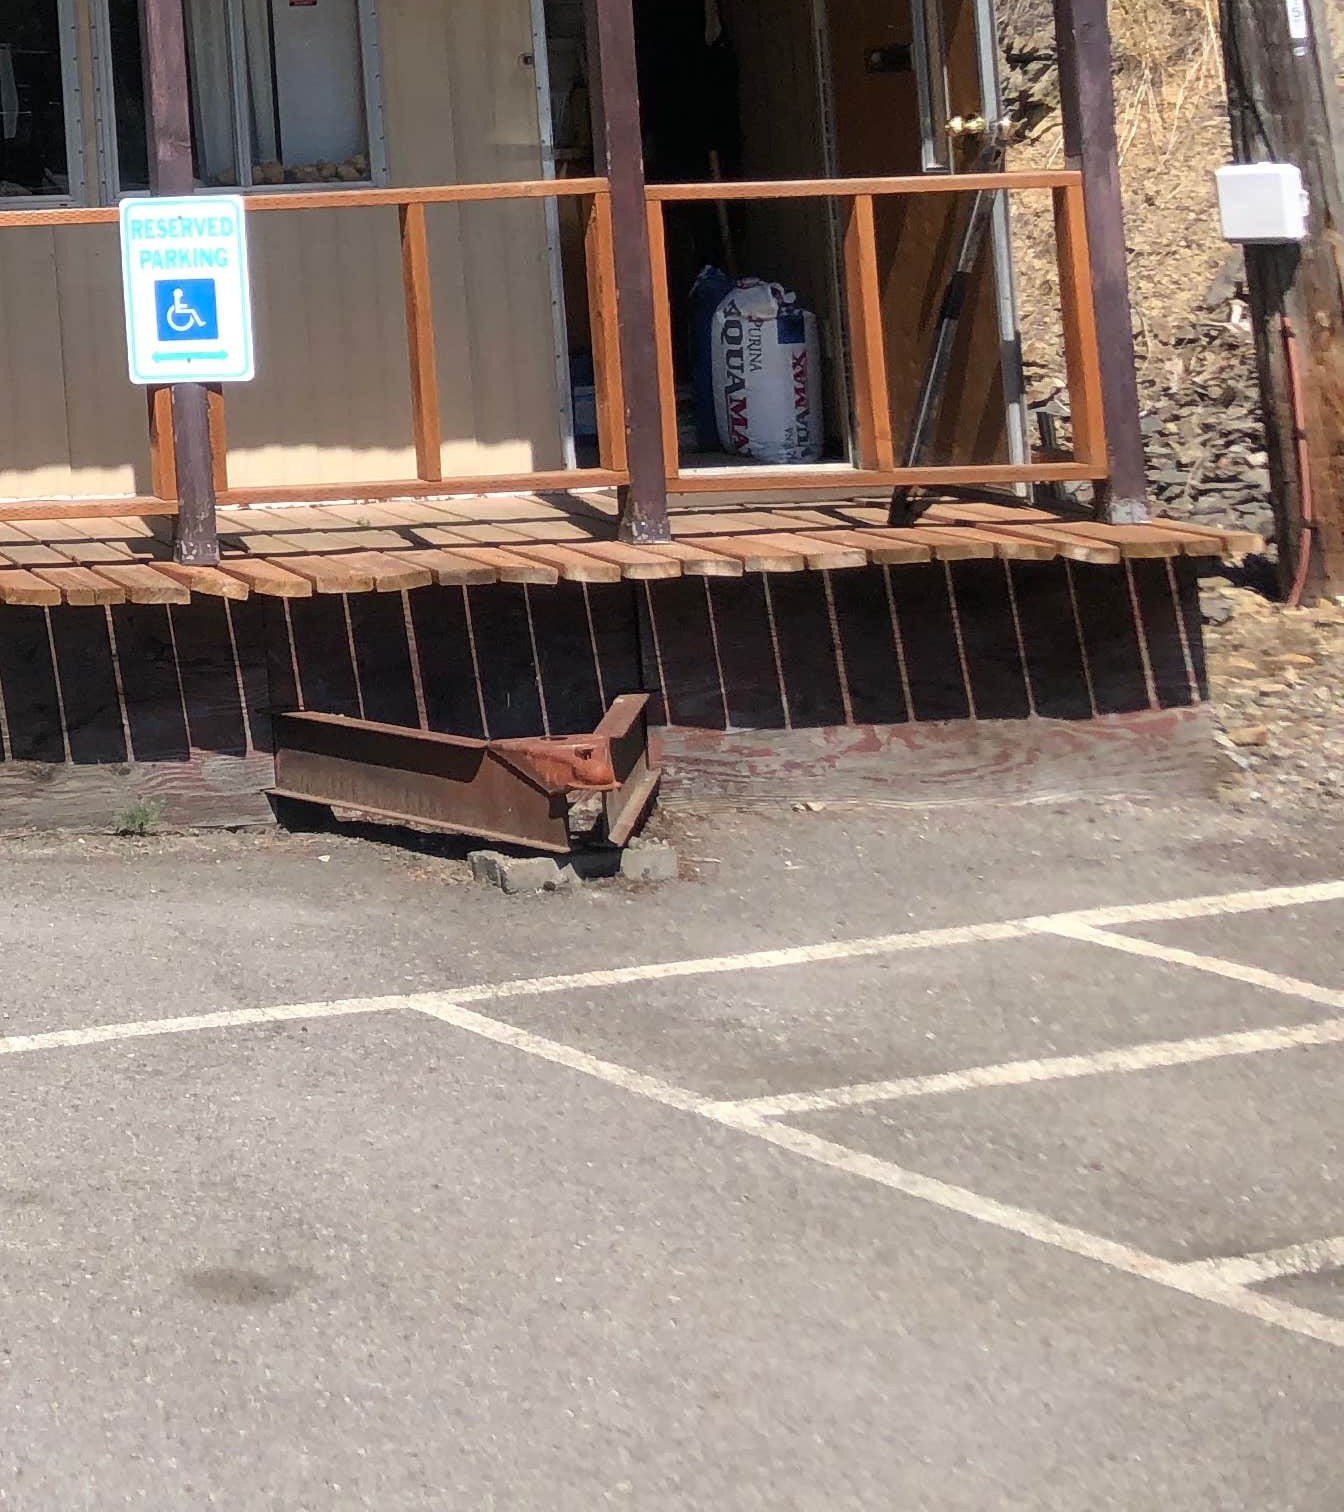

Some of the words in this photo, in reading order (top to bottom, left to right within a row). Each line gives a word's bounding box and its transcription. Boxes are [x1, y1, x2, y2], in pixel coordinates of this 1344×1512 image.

[131, 217, 234, 240] RESERVED
[139, 248, 229, 270] PARKING
[746, 316, 763, 373] PURINA
